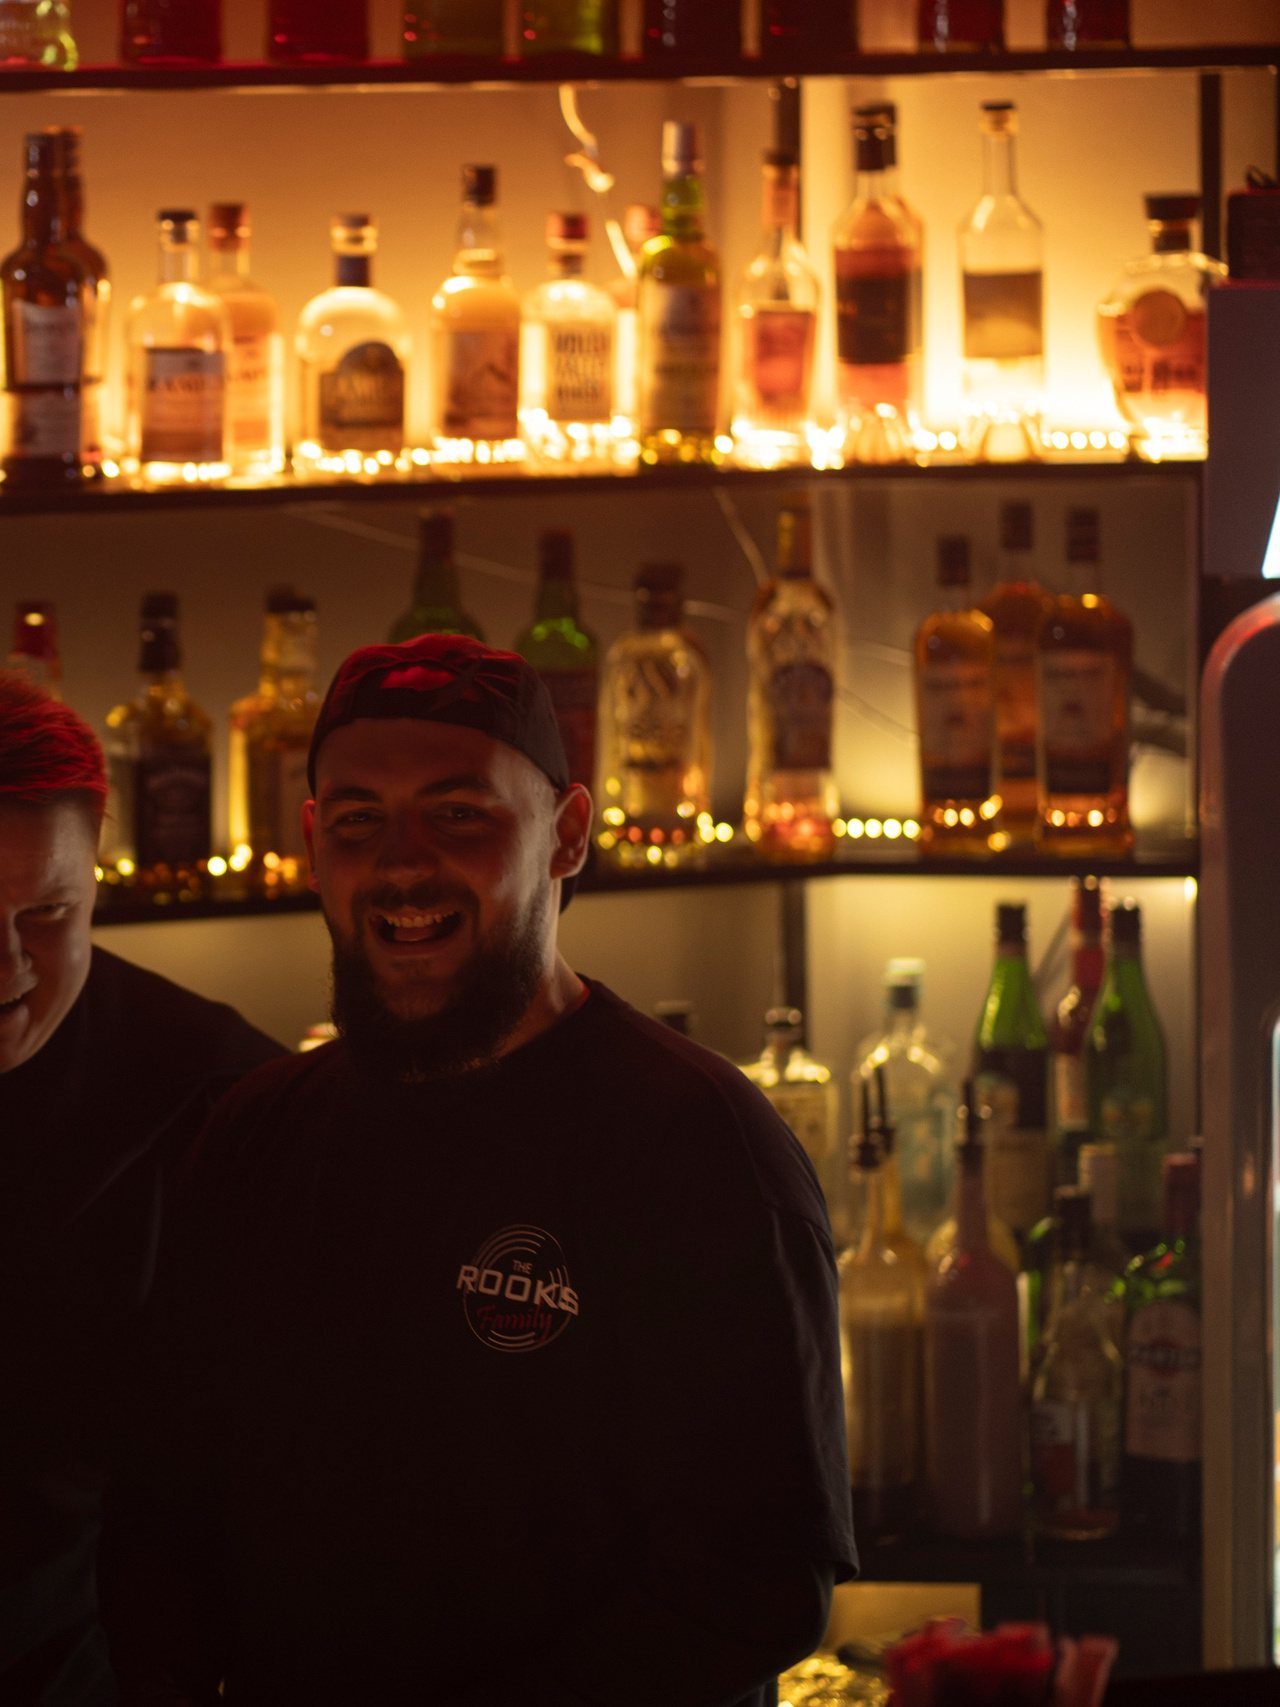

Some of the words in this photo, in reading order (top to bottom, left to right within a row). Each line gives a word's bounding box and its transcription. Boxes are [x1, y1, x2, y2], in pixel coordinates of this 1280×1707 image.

[513, 1259, 532, 1274] THE
[456, 1264, 579, 1316] ROOKS
[475, 1302, 553, 1344] Family
